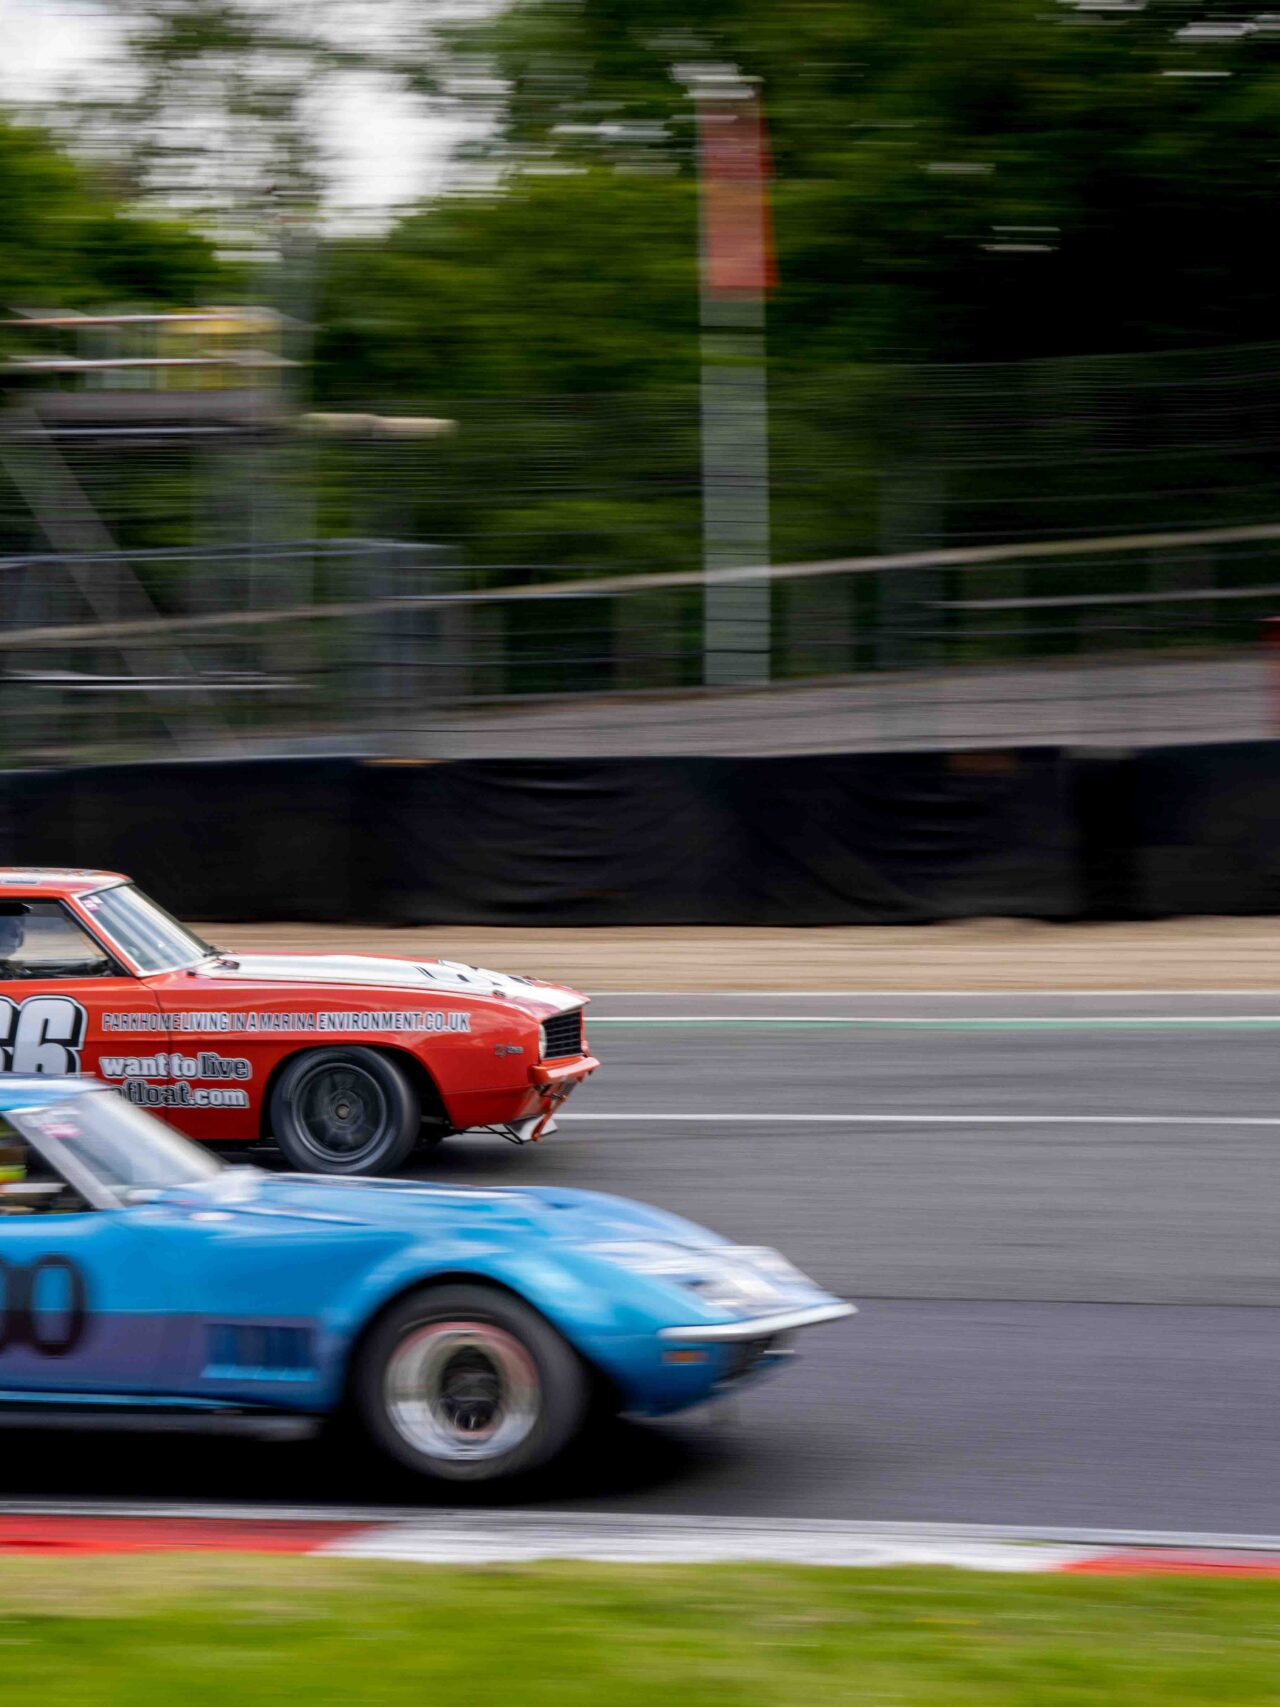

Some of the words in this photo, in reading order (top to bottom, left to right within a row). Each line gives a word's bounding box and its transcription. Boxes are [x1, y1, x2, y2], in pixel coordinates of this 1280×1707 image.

[100, 1054, 169, 1077] want
[170, 1054, 198, 1077] to
[199, 1053, 251, 1079] live
